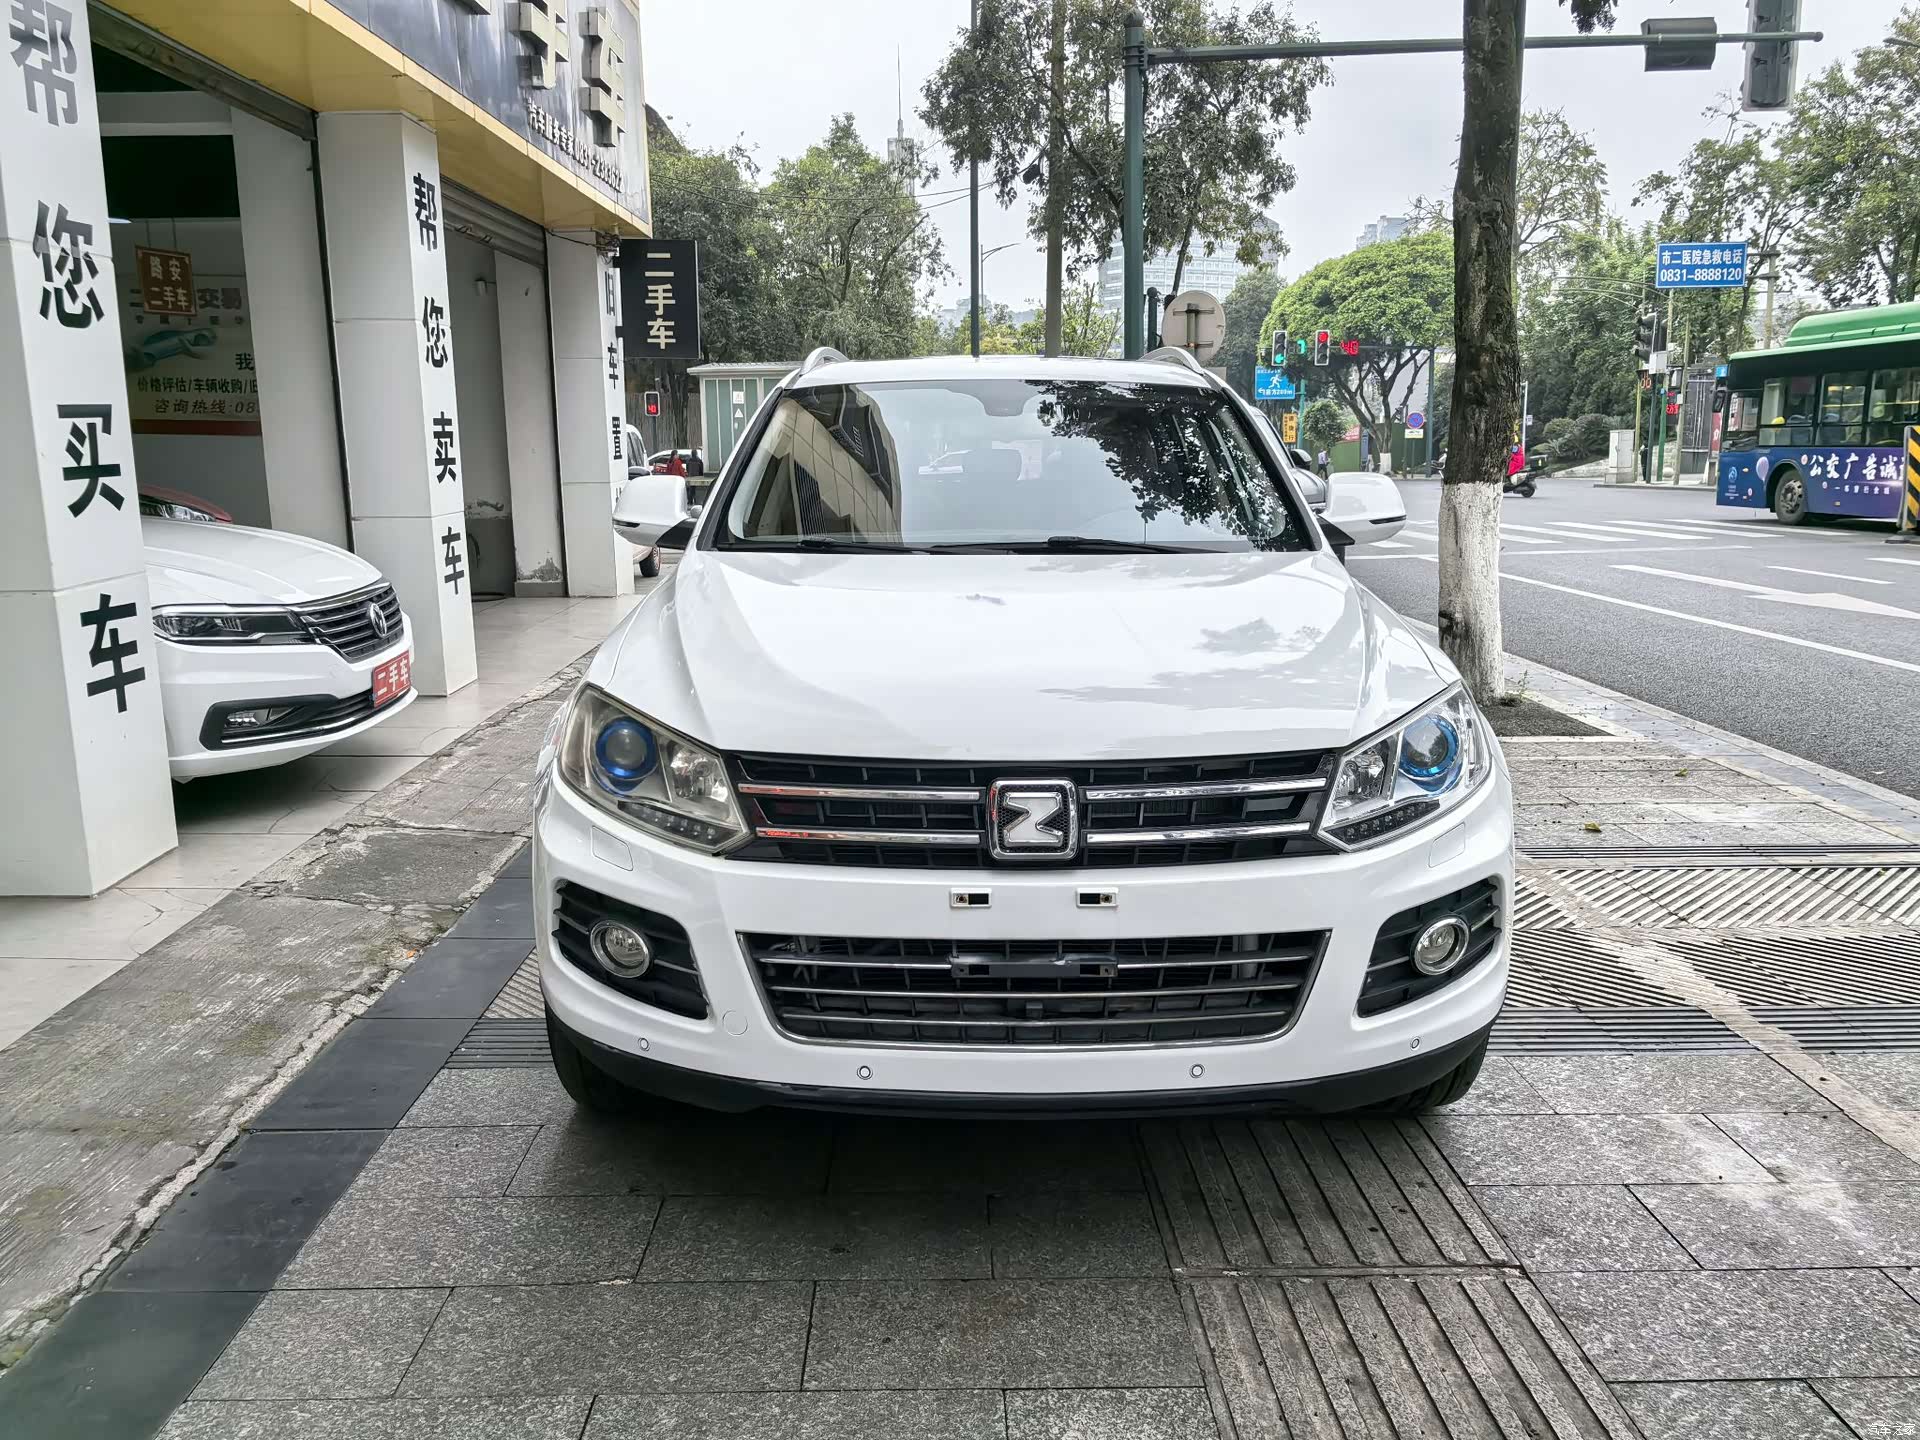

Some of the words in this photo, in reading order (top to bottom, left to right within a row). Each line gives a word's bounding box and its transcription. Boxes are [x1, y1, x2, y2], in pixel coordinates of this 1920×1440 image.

[1660, 267, 1743, 283] 0831-8888120
[1661, 248, 1743, 266] 市二医院急救电话
[149, 286, 189, 311] 二手车
[644, 252, 677, 350] 二手车
[8, 0, 146, 714] 帮您买车
[412, 171, 465, 595] 帮您卖车
[377, 657, 409, 697] 二手车
